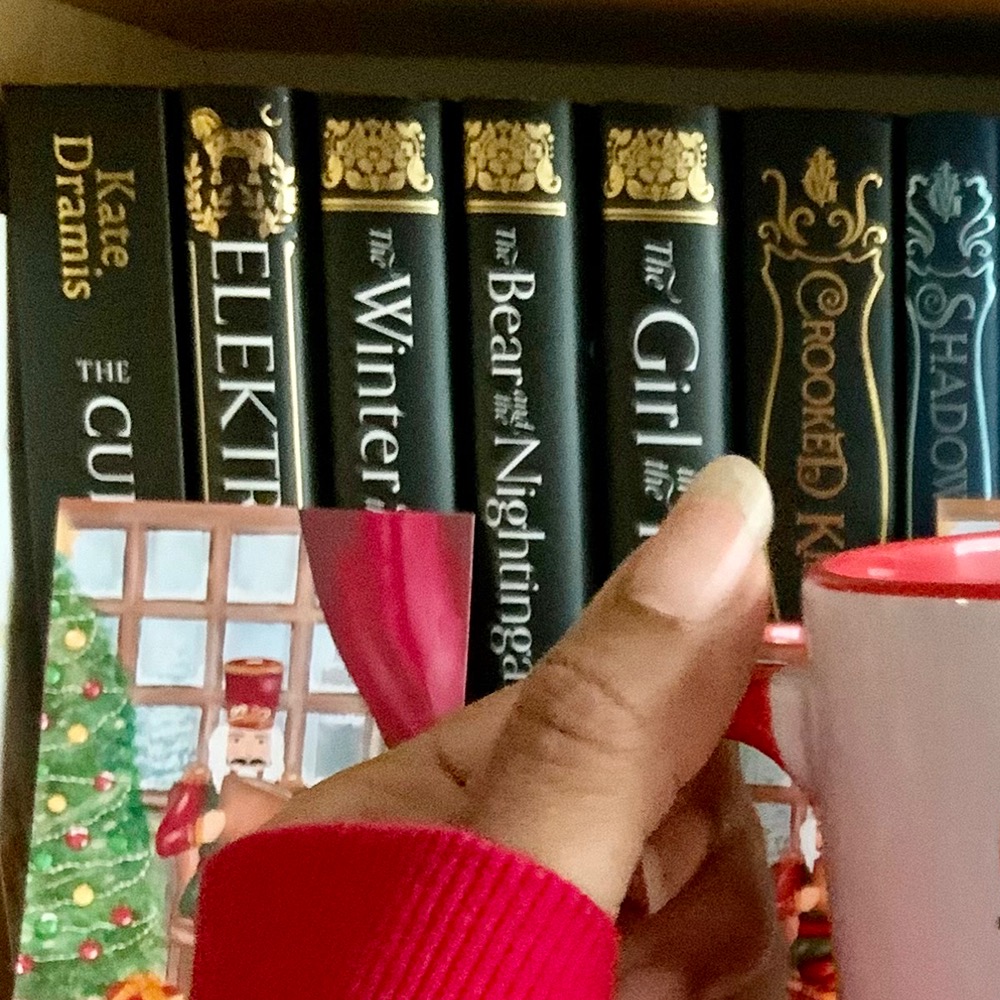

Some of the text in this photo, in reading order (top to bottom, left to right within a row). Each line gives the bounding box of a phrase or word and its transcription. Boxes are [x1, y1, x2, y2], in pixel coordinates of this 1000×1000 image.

[53, 133, 103, 300] Dramis
[95, 168, 136, 269] Kate
[367, 227, 396, 269] The
[76, 358, 131, 385] THE
[354, 272, 414, 495] Winter
[488, 272, 537, 387] Bear
[633, 239, 703, 447] The Girl
[796, 270, 849, 500] CROOKED
[84, 396, 137, 503] CU
